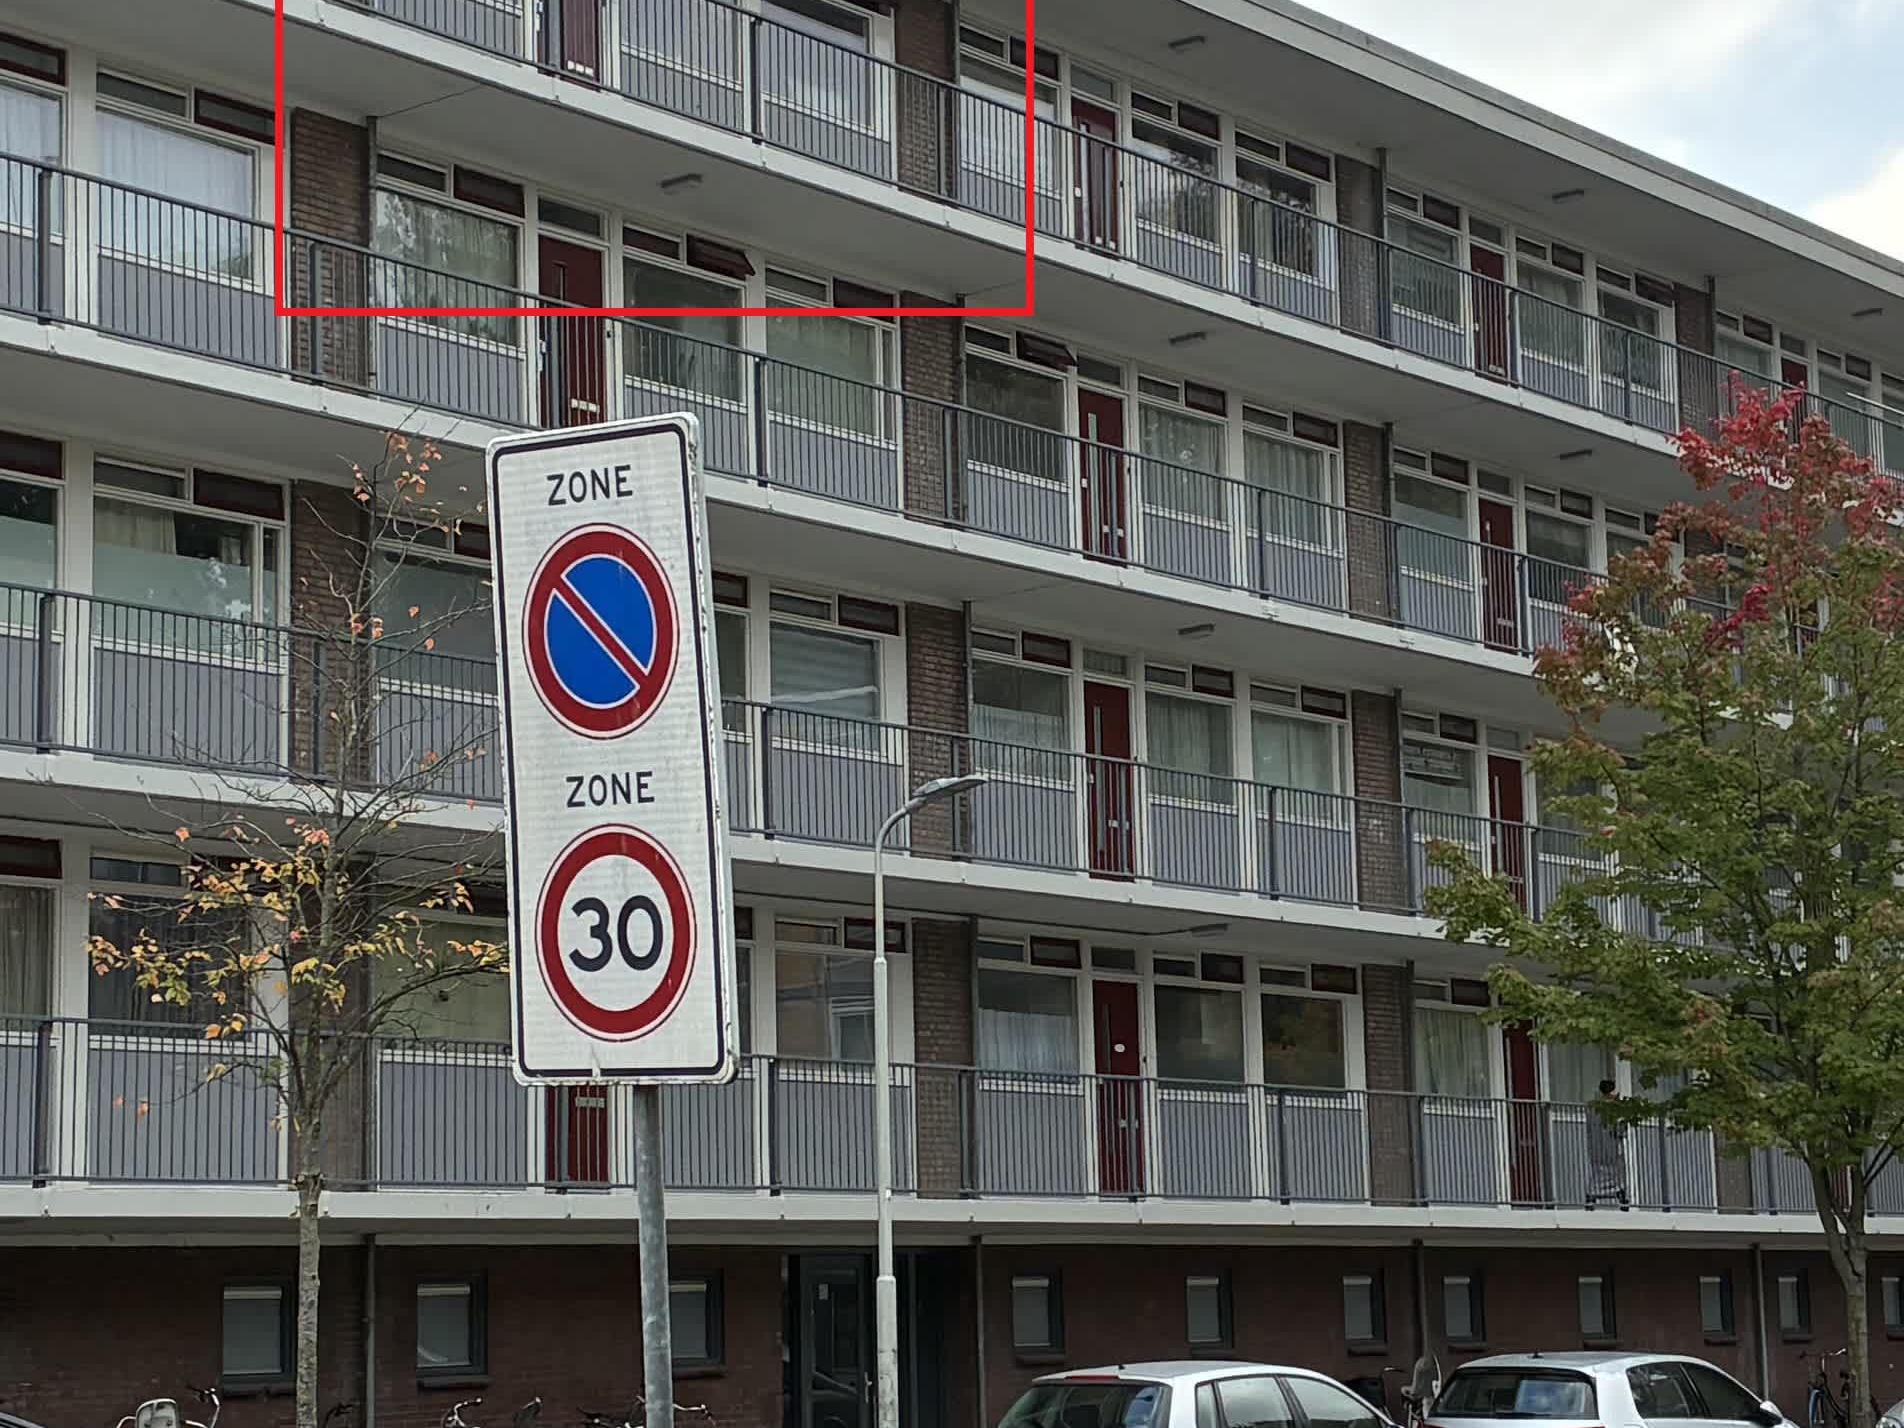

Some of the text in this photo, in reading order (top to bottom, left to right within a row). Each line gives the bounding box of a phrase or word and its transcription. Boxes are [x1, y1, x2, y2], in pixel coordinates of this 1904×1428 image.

[547, 464, 633, 506] ZONE
[566, 771, 655, 808] ZONE
[569, 895, 663, 972] 30
